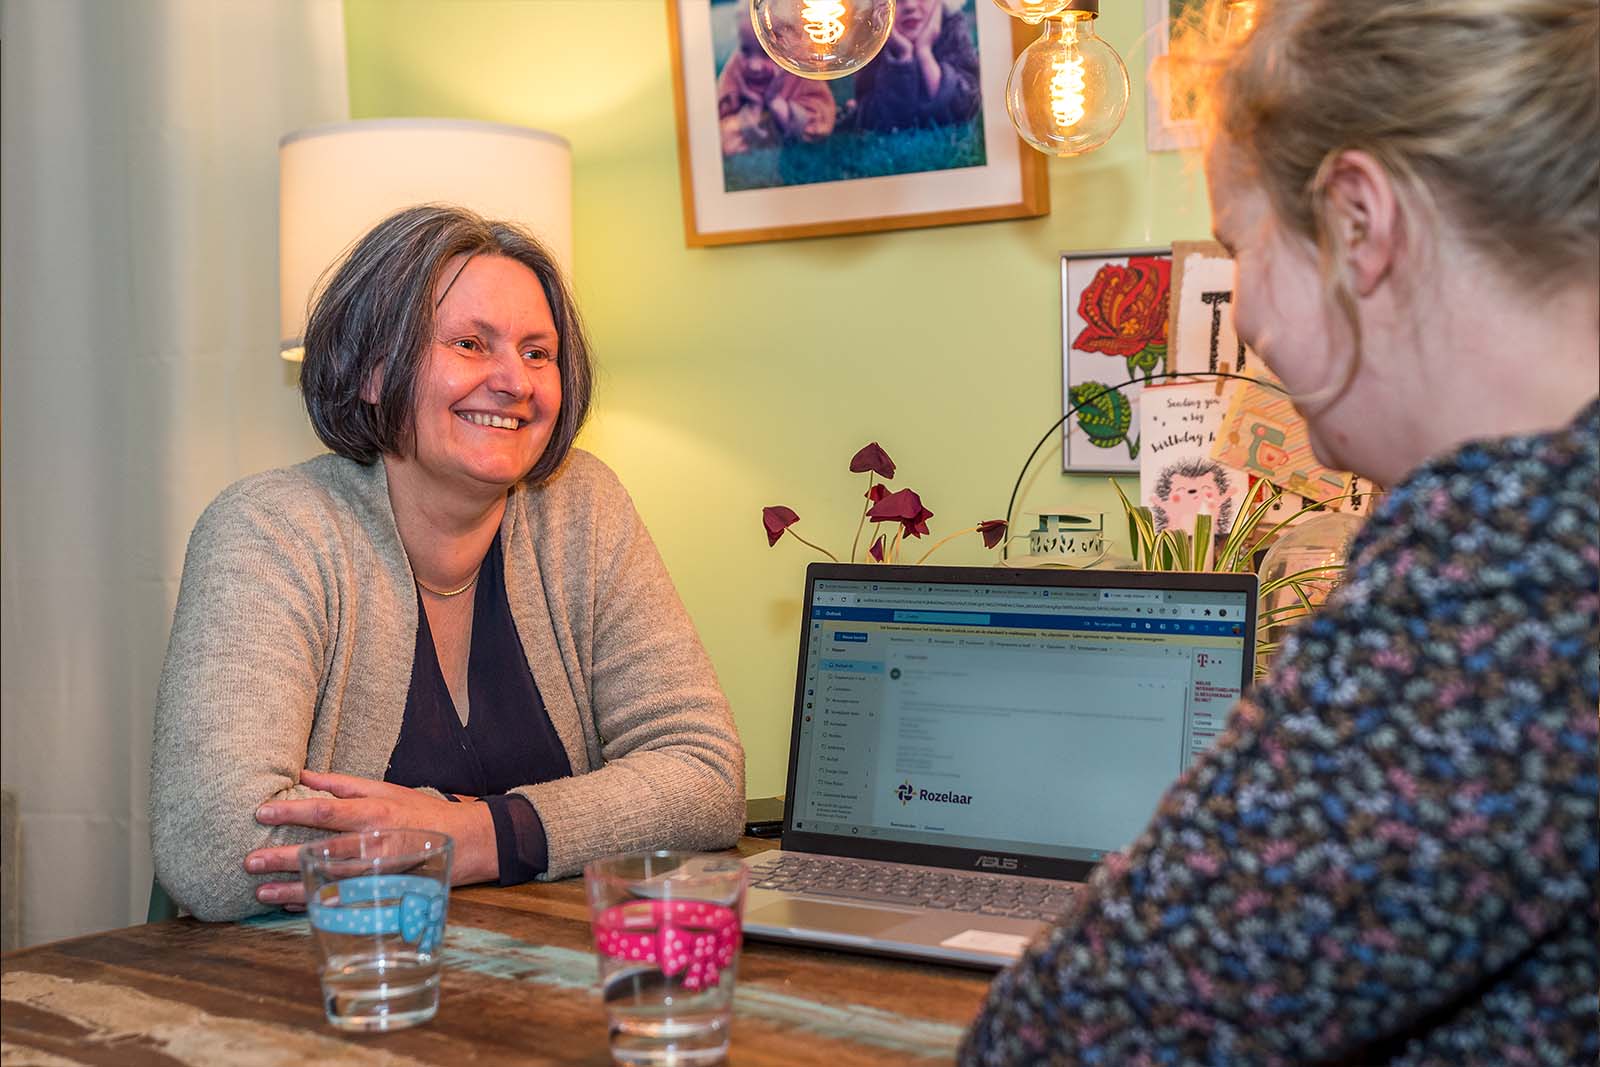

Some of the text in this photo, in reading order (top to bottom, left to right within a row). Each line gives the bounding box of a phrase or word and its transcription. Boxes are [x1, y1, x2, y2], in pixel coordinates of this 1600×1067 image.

[1167, 397, 1221, 409] Sending you
[1190, 412, 1204, 424] big
[1150, 431, 1203, 453] birthday
[919, 788, 973, 805] Rozelaar
[974, 855, 1019, 870] ASUS
